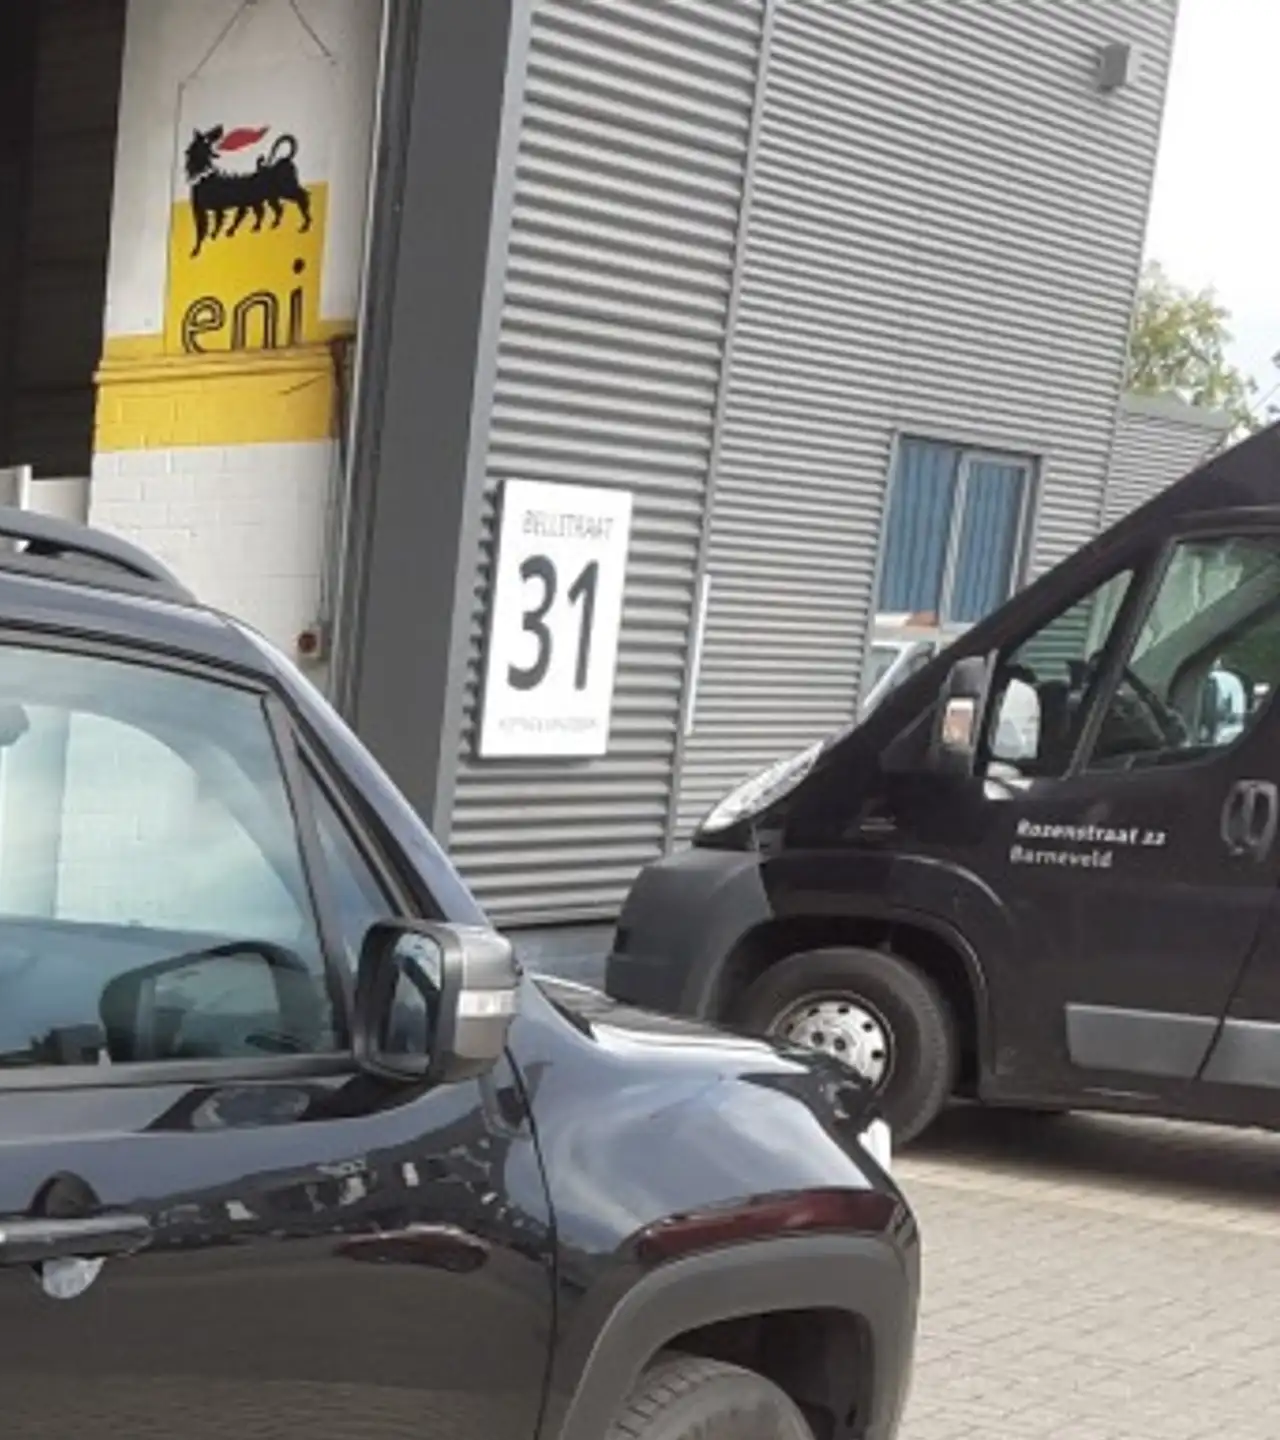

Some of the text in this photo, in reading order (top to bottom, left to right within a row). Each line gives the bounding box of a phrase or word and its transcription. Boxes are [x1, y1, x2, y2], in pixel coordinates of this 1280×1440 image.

[181, 257, 306, 353] eni
[506, 553, 600, 692] 31
[1009, 844, 1114, 869] Barneveld
[1016, 818, 1139, 846] Rozenstraat
